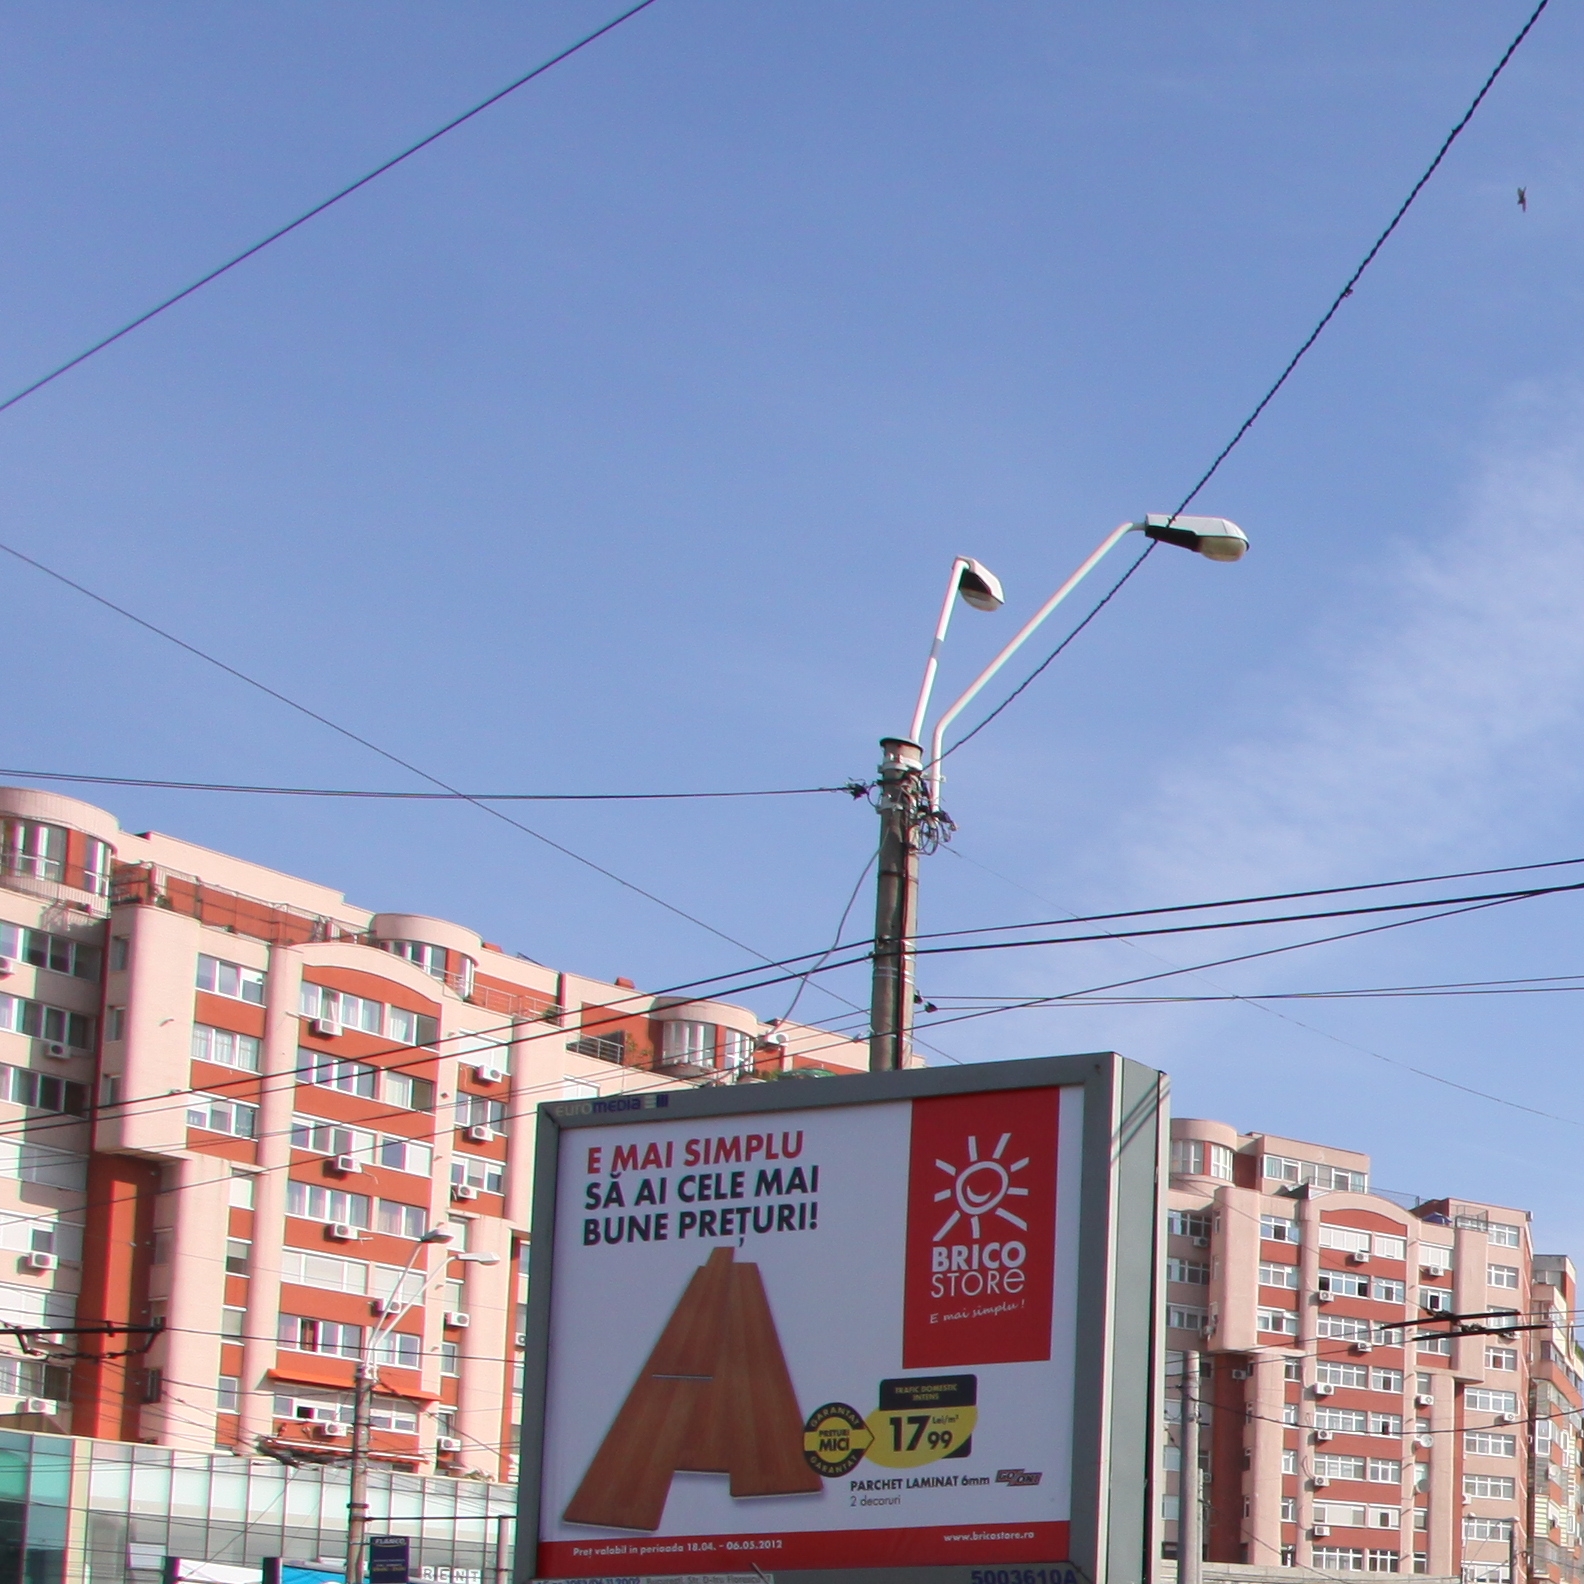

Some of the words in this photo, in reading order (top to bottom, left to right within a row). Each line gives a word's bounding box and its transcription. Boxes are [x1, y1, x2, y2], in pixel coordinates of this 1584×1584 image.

[587, 1147, 602, 1174] E
[611, 1141, 673, 1172] MAI
[683, 1130, 803, 1167] SIMPLU
[584, 1172, 625, 1210] SĂ
[634, 1177, 667, 1206] AI
[677, 1170, 745, 1203] CELE
[754, 1165, 819, 1197] MAI
[583, 1212, 669, 1246] BUNE
[931, 1241, 1026, 1272] BRICO
[929, 1312, 939, 1324] E
[943, 1308, 969, 1321] mai
[971, 1301, 1018, 1318] simplu
[811, 1406, 860, 1428] GARANTAT
[889, 1415, 931, 1452] 17
[927, 1430, 953, 1450] 99
[819, 1438, 850, 1452] MICI
[810, 1454, 857, 1473] GARANTAT
[850, 1478, 903, 1492] PARCHET
[906, 1475, 960, 1489] LAMINAT
[961, 1475, 990, 1487] 6mm
[850, 1496, 857, 1507] 2
[860, 1494, 902, 1507] decoruri
[943, 1531, 1035, 1542] www.bricostore.ro
[595, 1546, 627, 1556] valabil
[640, 1544, 684, 1555] perioada
[726, 1540, 783, 1551] 06.05.2012
[423, 1568, 480, 1583] RENT
